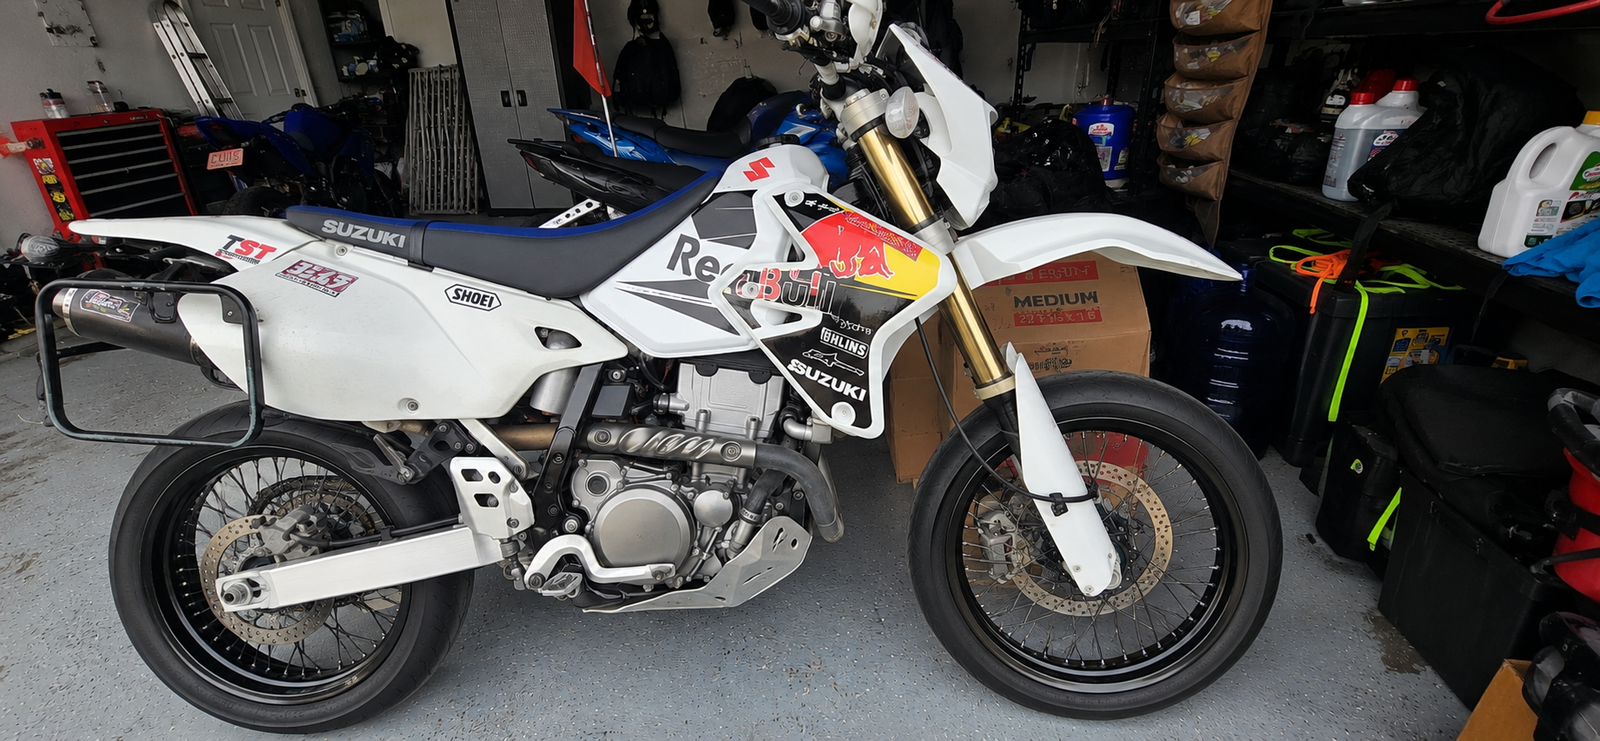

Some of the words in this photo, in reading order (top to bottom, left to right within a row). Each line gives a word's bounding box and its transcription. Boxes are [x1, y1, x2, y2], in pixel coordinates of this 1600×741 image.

[222, 234, 277, 260] TST
[322, 219, 406, 248] SUZUKI
[667, 234, 734, 283] Re
[452, 287, 495, 308] SHOEI
[1014, 291, 1099, 308] MEDIUM
[787, 358, 867, 402] SUZUKI
